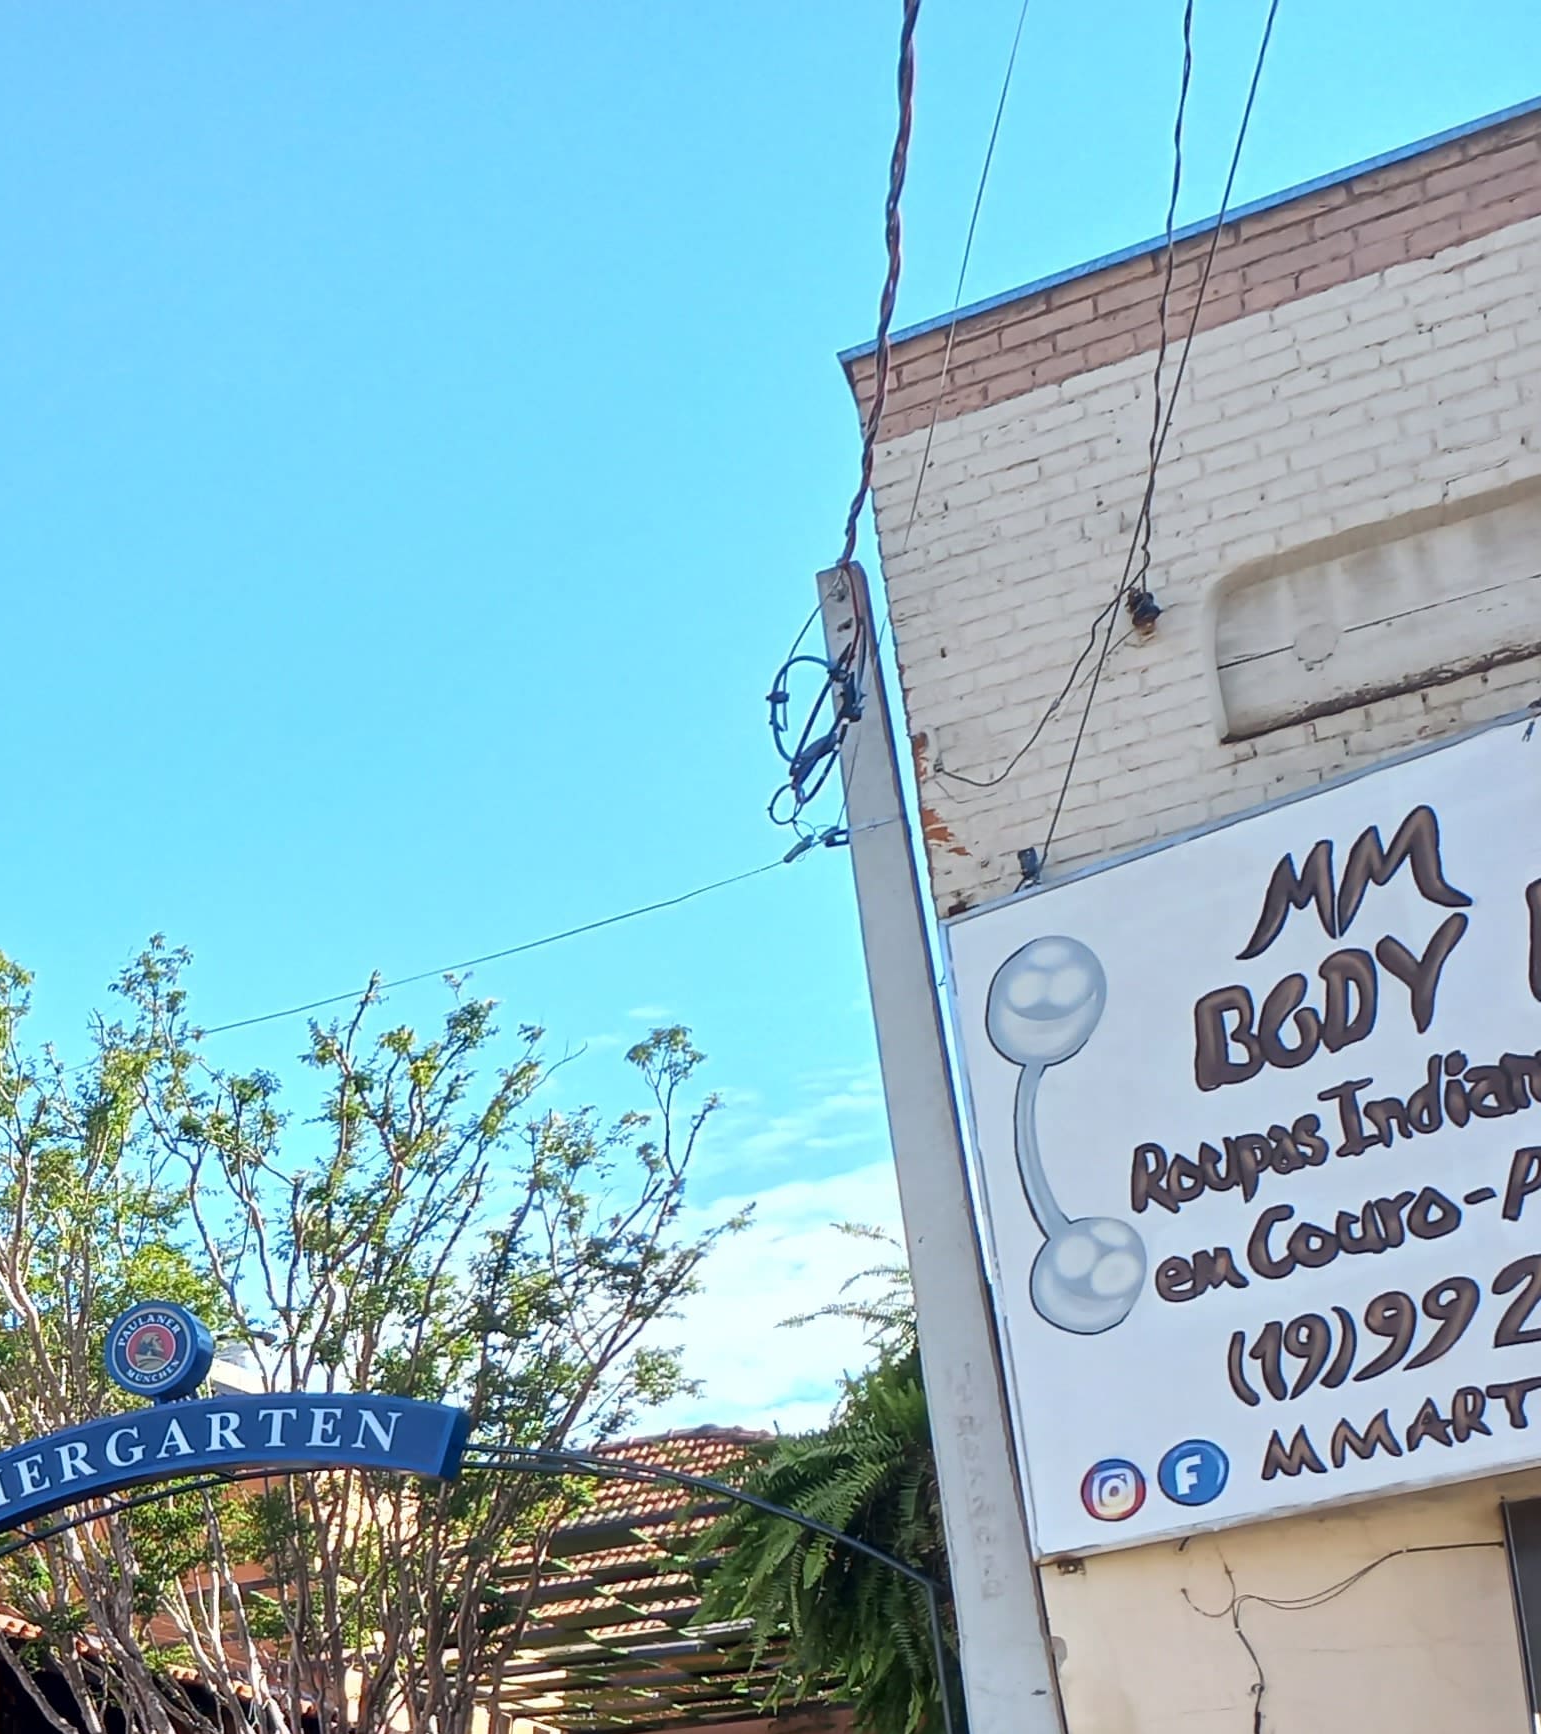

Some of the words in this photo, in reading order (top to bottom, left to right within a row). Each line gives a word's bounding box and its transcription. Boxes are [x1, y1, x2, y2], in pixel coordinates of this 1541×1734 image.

[1235, 804, 1473, 960] MM
[1130, 1113, 1330, 1214] Roupas
[1155, 1247, 1250, 1303] em
[117, 1313, 182, 1347] PAULANER
